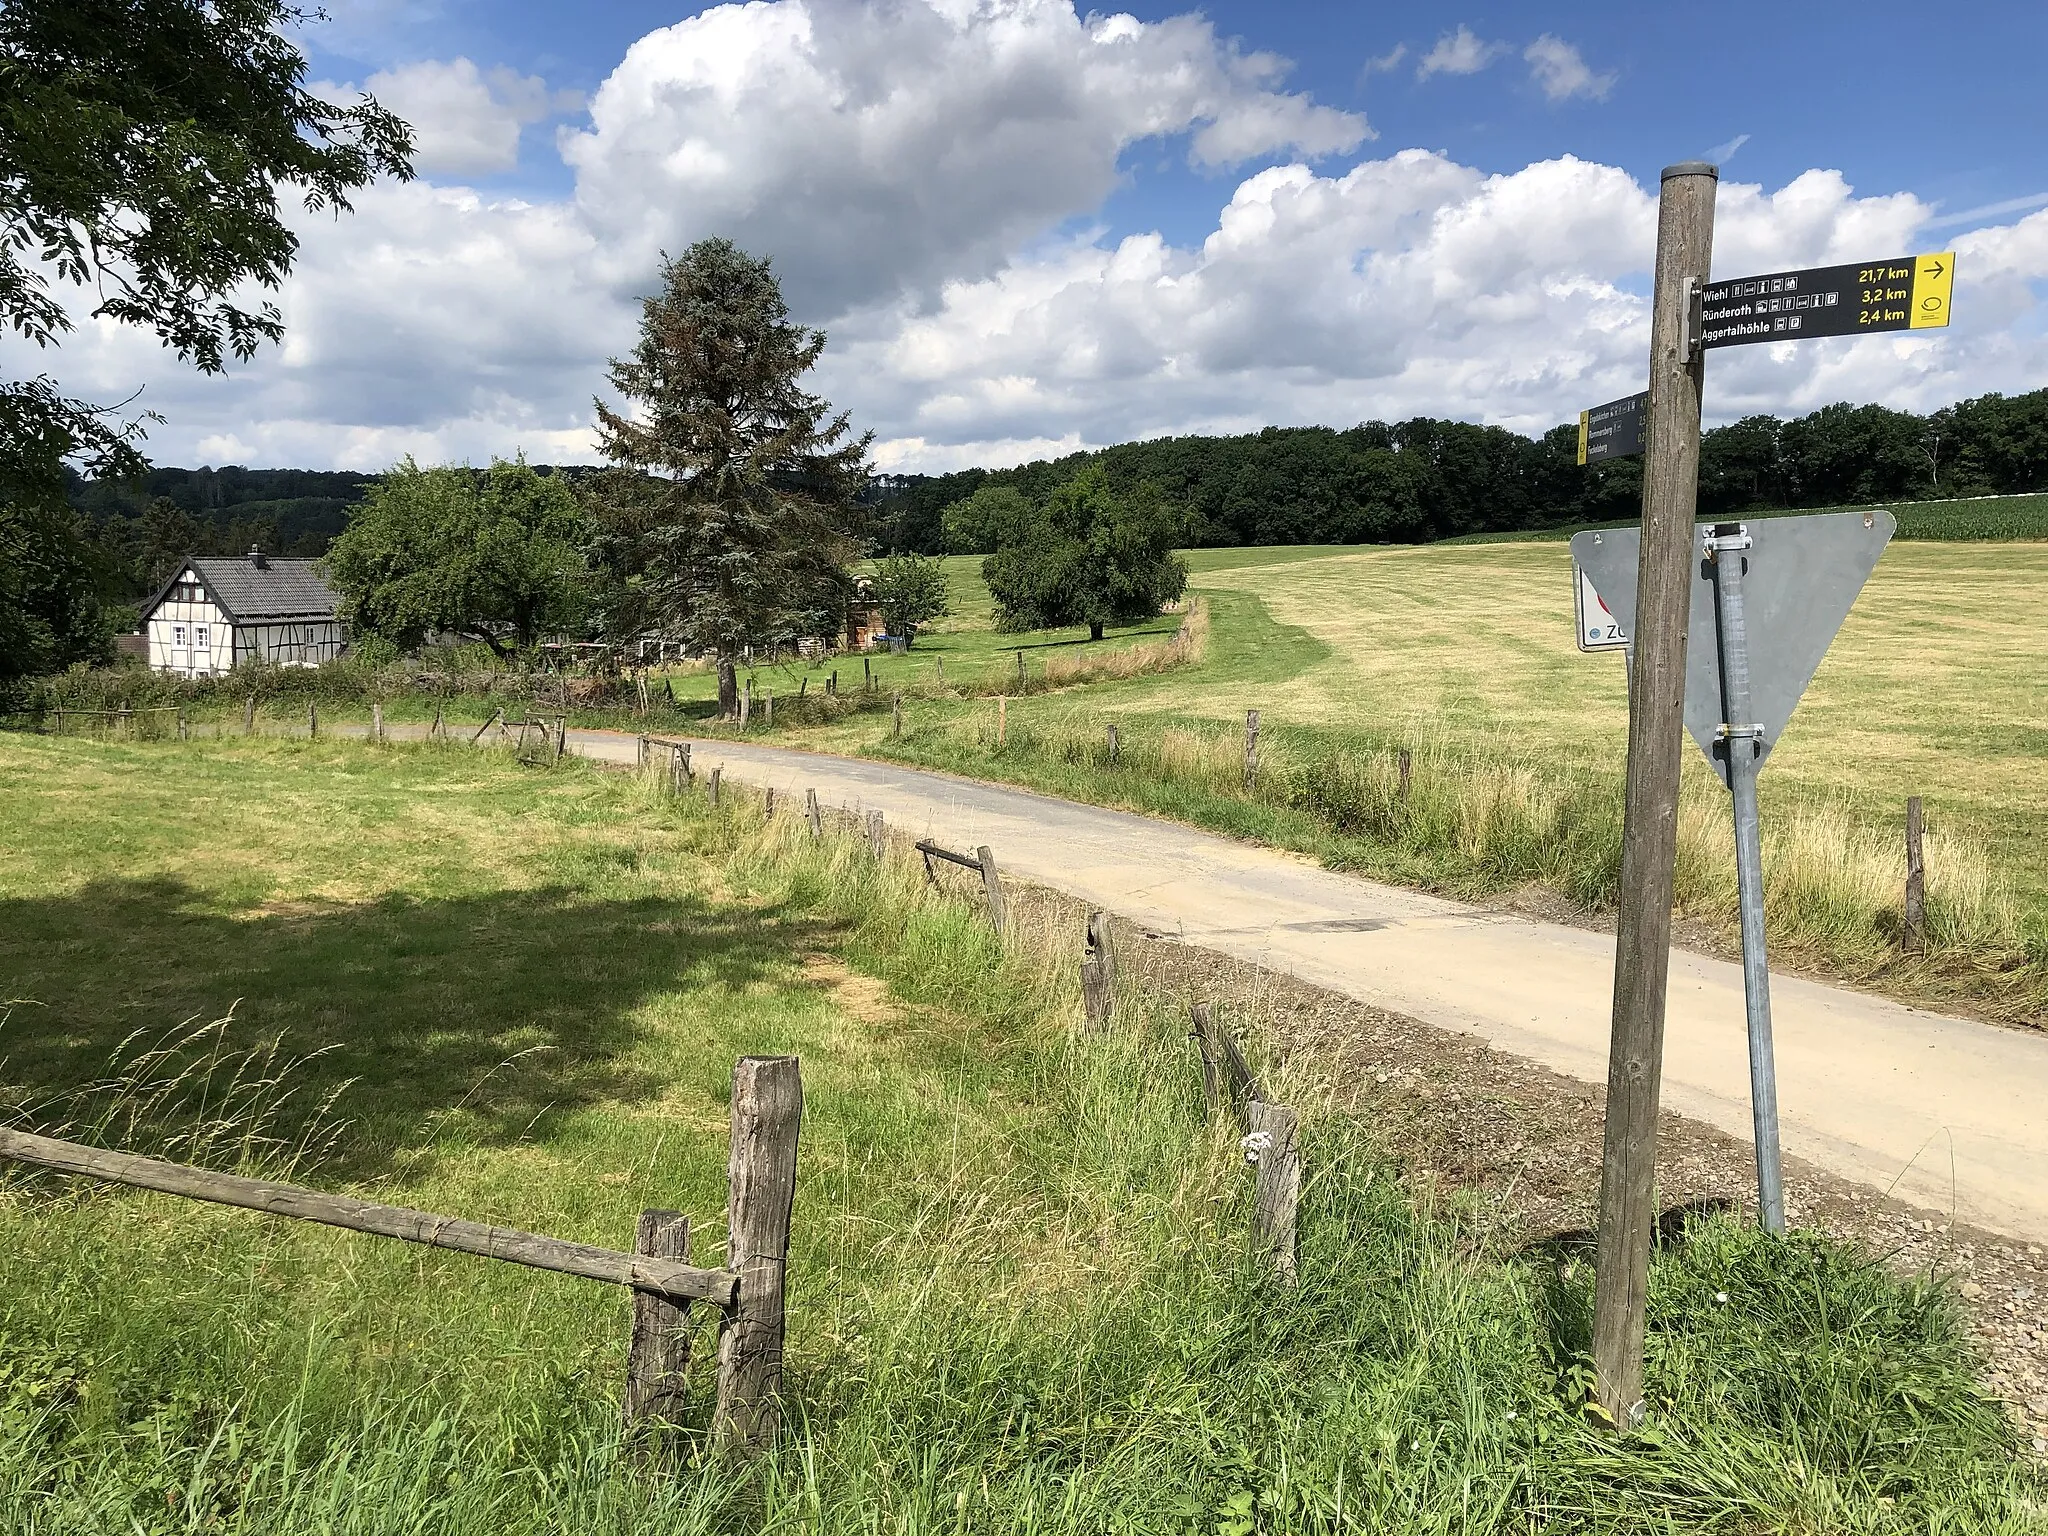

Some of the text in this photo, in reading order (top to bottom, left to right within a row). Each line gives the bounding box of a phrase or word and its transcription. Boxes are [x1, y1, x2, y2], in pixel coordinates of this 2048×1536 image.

[1703, 267, 1909, 302] Wiehl 21,7 km
[1702, 288, 1907, 321] Ründeroth 3,2 km
[1701, 322, 1770, 342] Aggertalhöhle
[1859, 310, 1881, 325] 2,4
[1884, 309, 1905, 321] km
